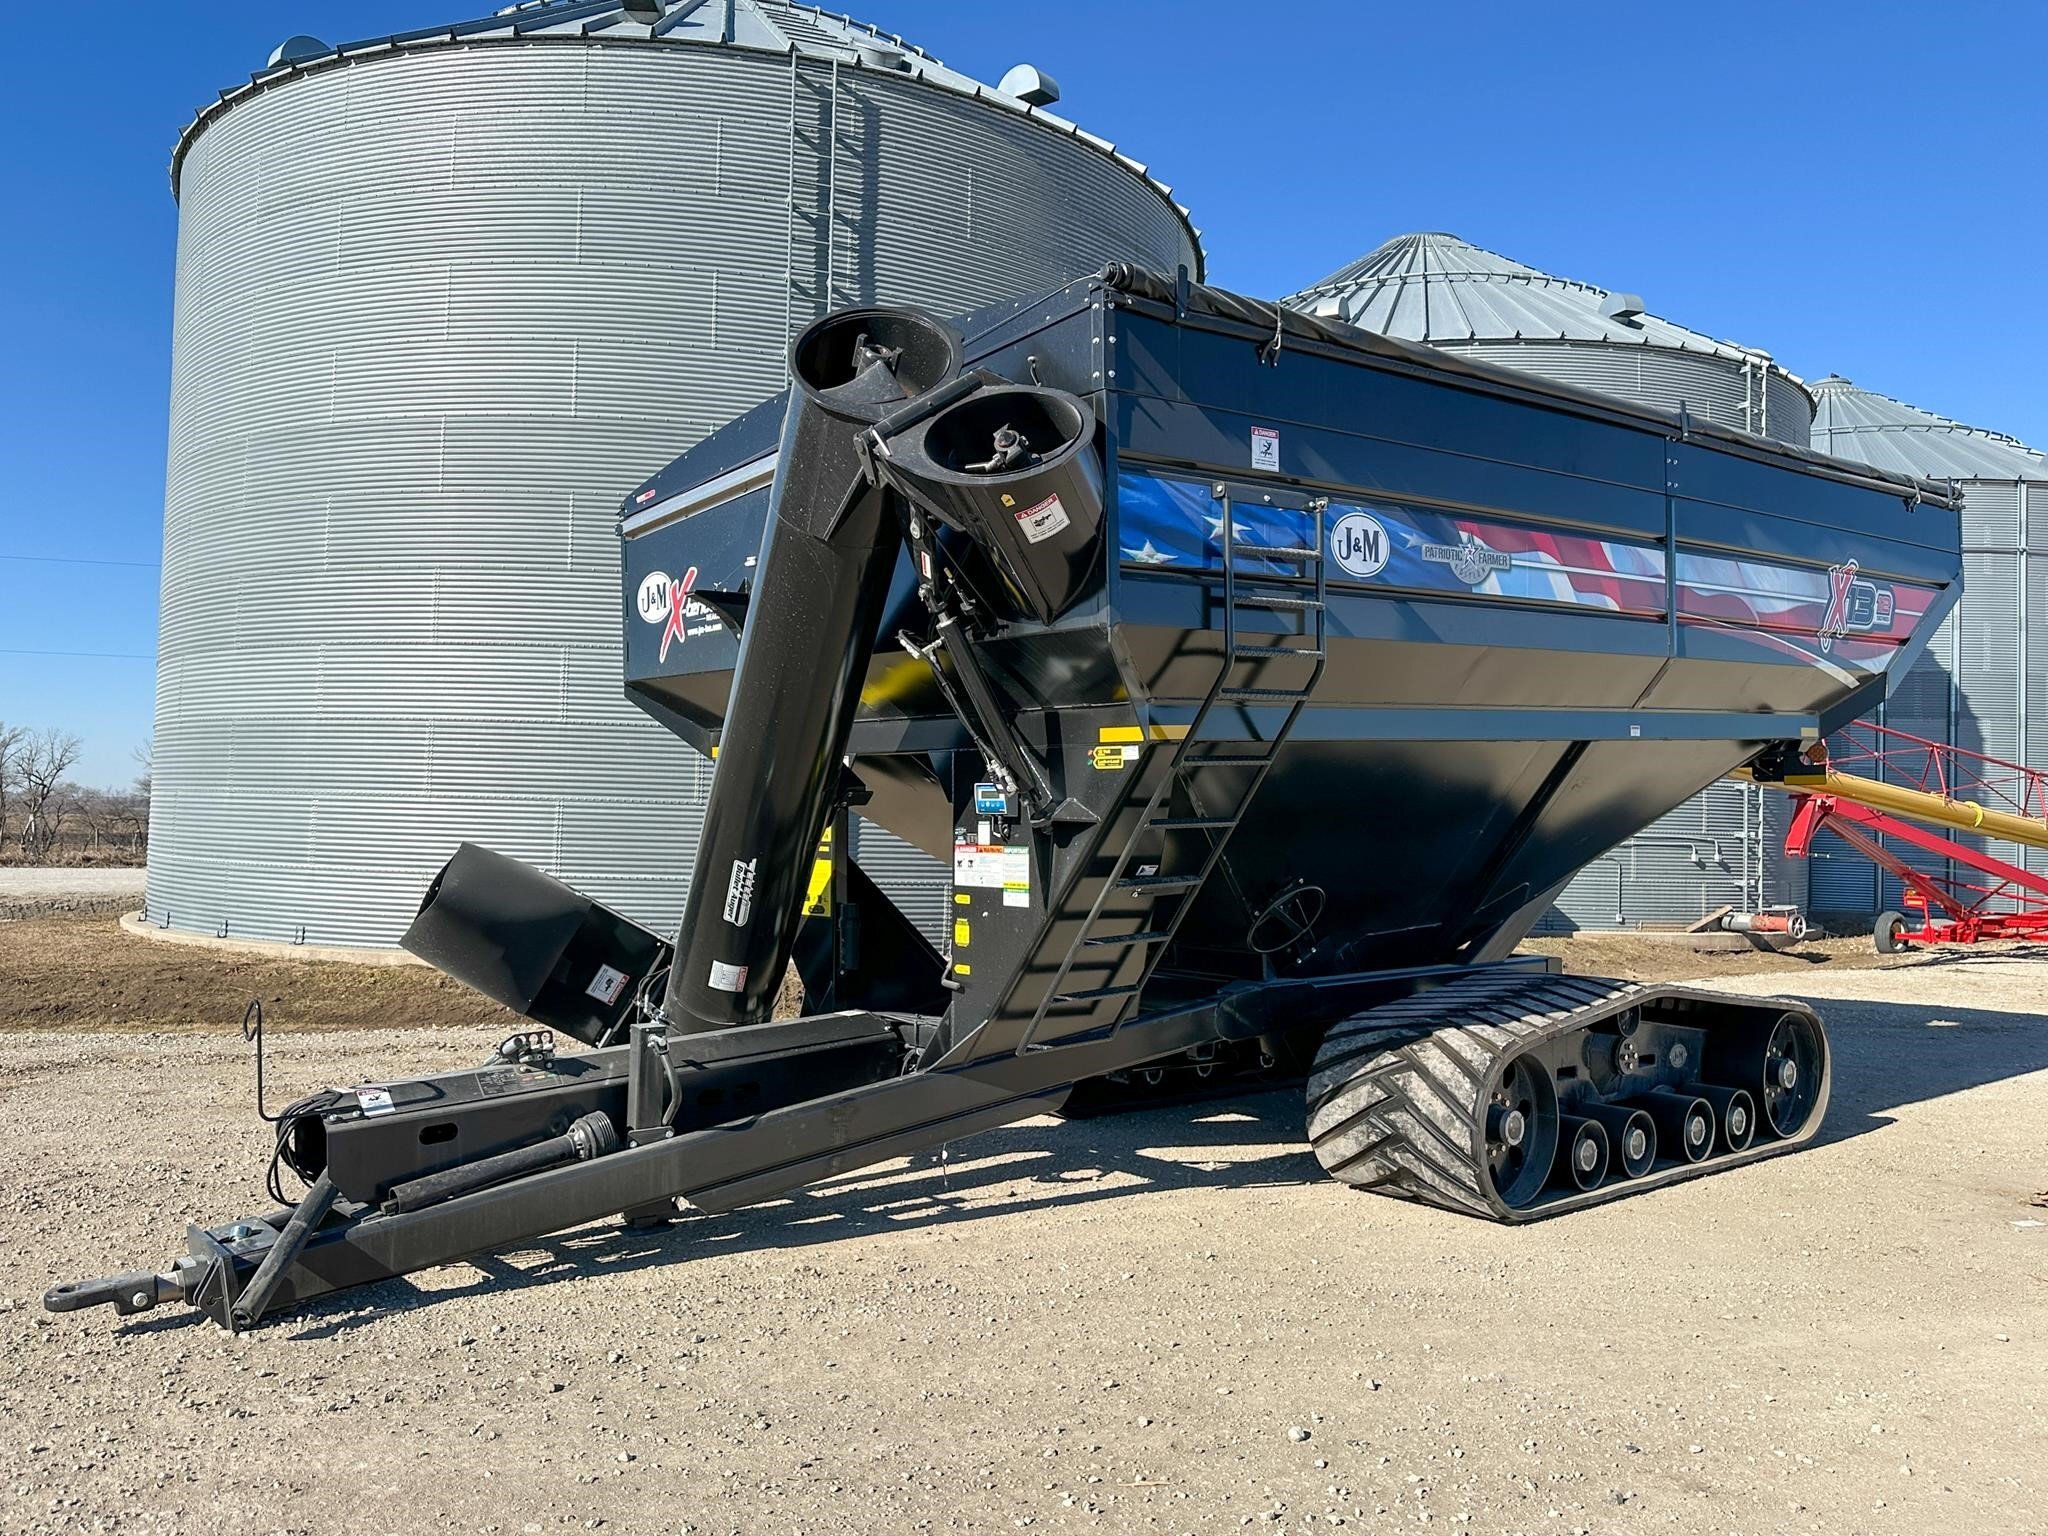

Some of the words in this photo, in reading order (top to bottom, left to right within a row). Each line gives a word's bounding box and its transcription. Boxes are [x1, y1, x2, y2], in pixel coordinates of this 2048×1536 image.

[1337, 527, 1380, 564] J&M
[1424, 545, 1463, 562] PATRIOTIC
[1478, 552, 1508, 567] FARMER
[641, 582, 668, 613] J&M
[733, 864, 744, 891] Bullet
[727, 894, 738, 919] Auger
